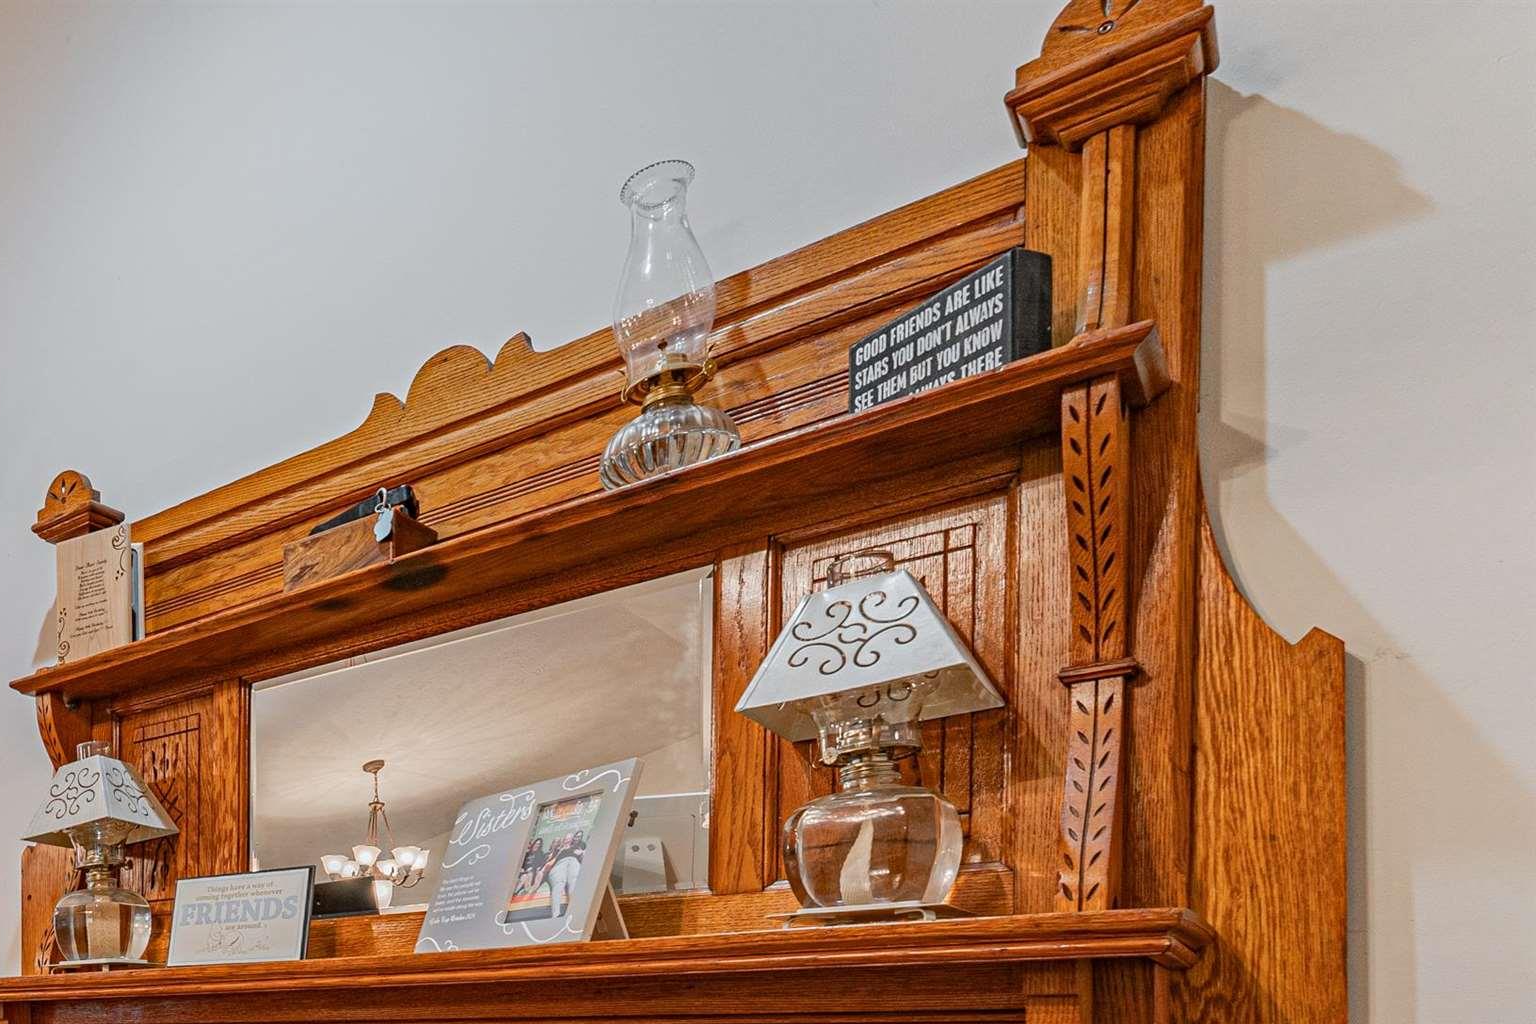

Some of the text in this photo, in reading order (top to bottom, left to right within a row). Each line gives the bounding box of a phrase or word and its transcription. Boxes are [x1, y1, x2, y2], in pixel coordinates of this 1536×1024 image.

[855, 265, 1004, 366] GOOD FRIENDS ARE LIKE
[855, 293, 1004, 390] STARS YOU DON'T ALWAYS
[960, 346, 1003, 379] THERE
[854, 319, 1004, 413] SEE THEM BUT YOU KNOW
[180, 895, 298, 926] FRIENDS
